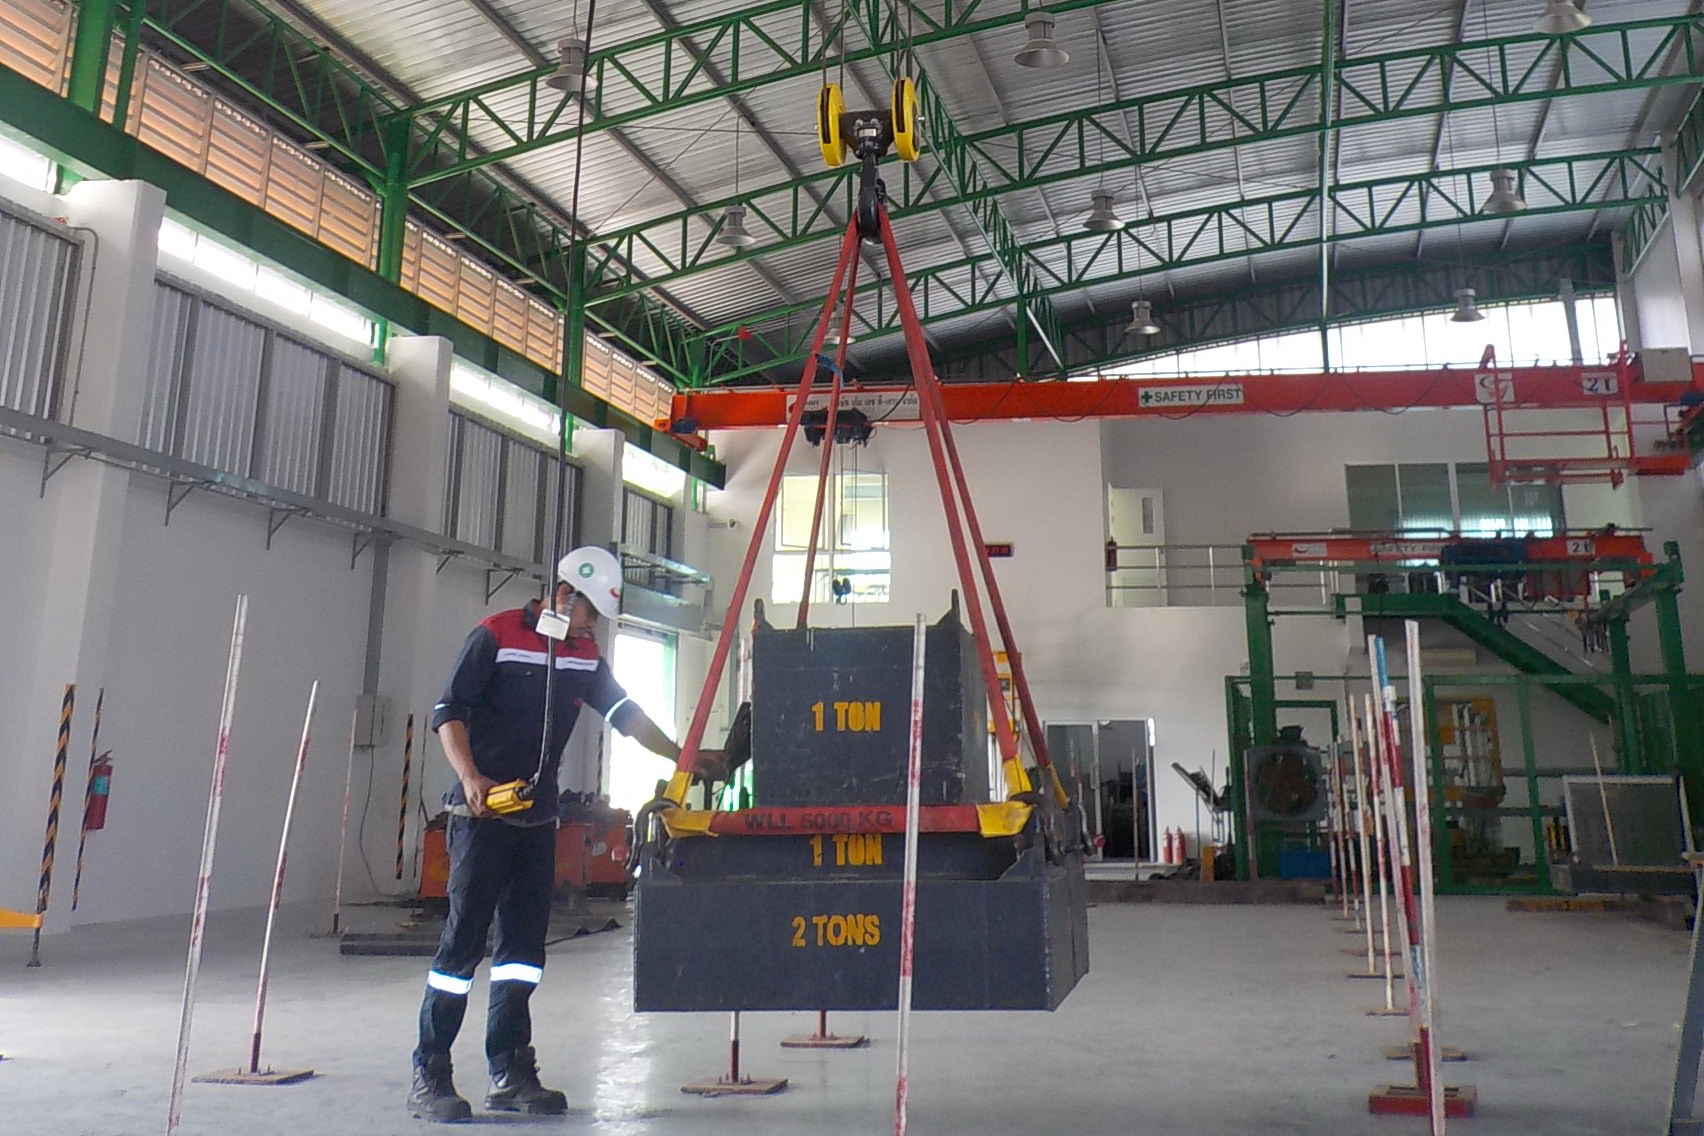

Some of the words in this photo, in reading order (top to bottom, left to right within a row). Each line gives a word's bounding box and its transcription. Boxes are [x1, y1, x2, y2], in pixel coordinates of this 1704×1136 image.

[1154, 389, 1203, 403] SAFETY
[1206, 388, 1242, 401] FIRST
[811, 702, 824, 732] 1
[834, 701, 881, 732] TON
[743, 812, 794, 831] WLL
[801, 812, 852, 830] 5000
[858, 810, 893, 827] KG
[810, 834, 823, 866] 1
[832, 833, 883, 866] TON
[791, 915, 807, 947] 2
[812, 914, 881, 947] TONS
